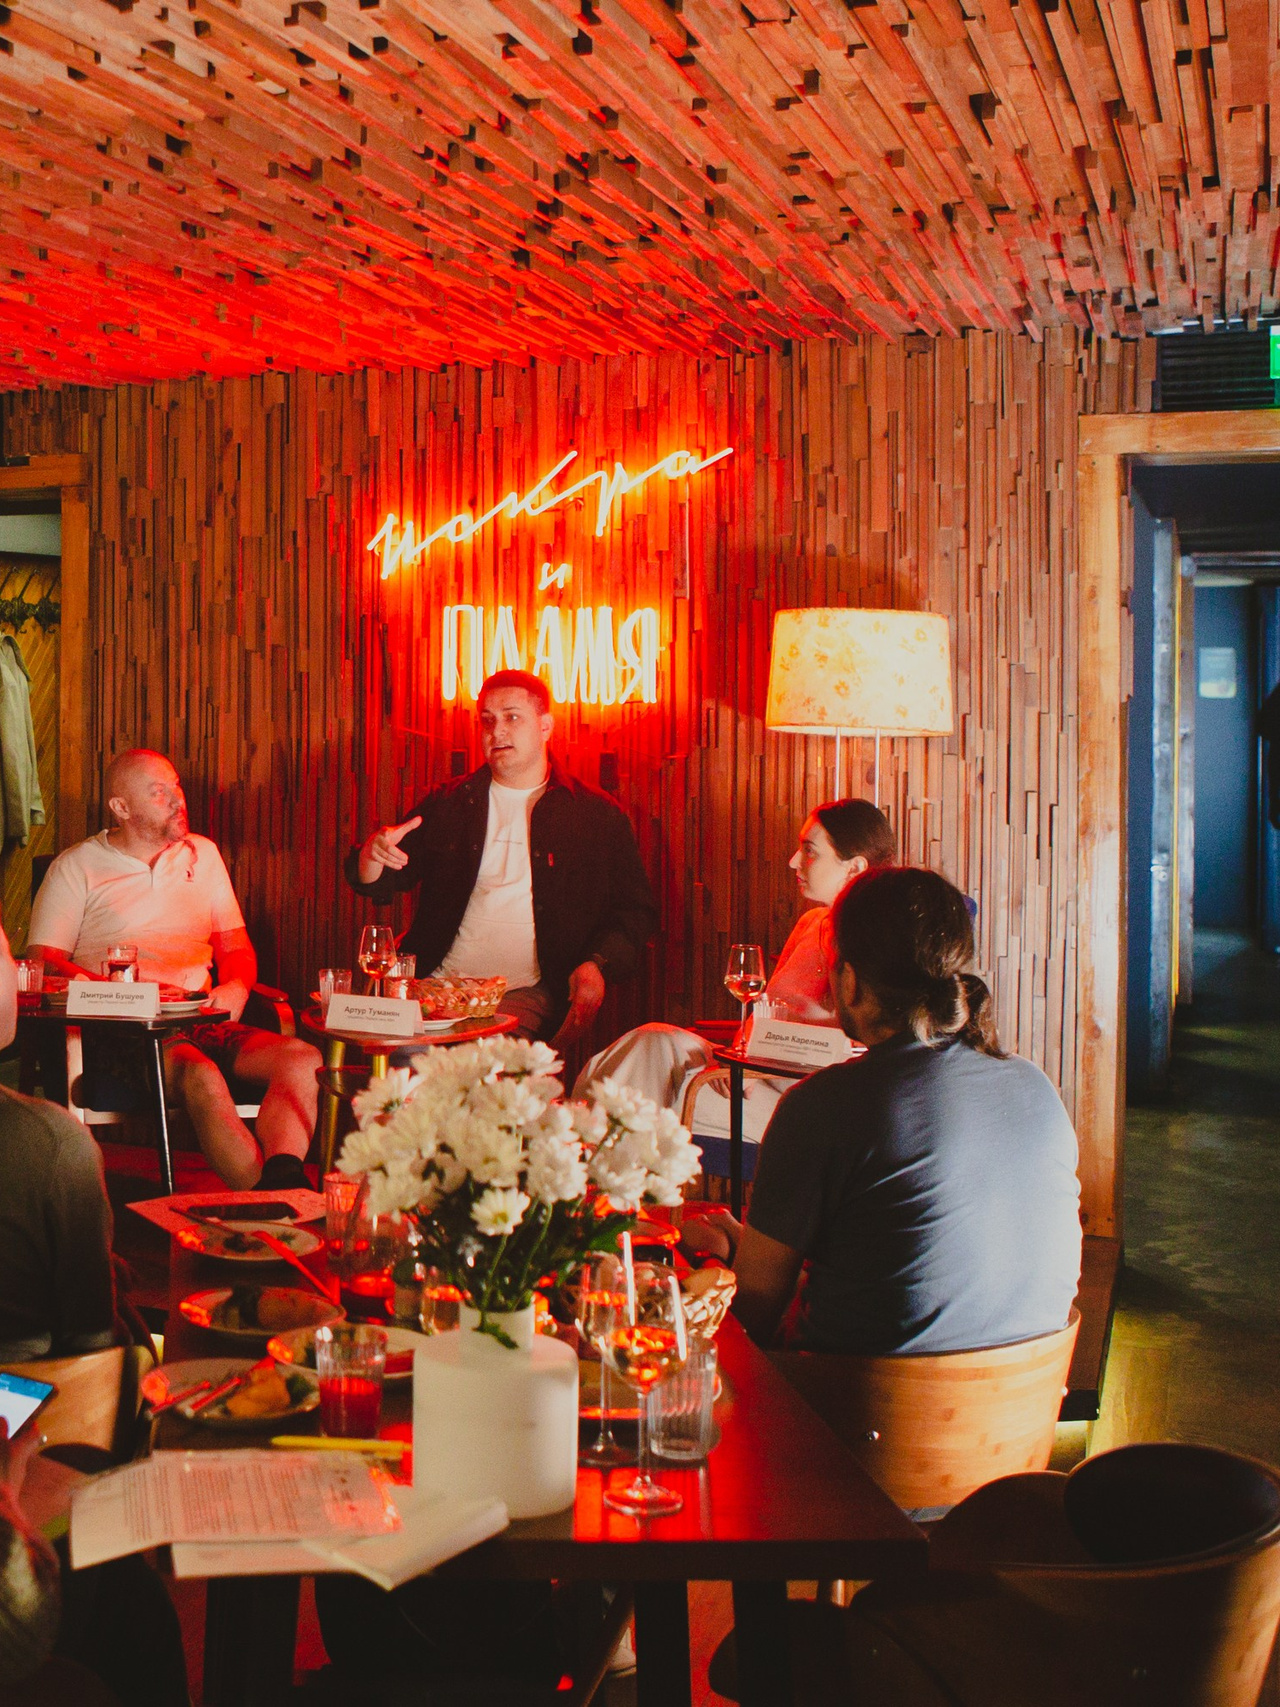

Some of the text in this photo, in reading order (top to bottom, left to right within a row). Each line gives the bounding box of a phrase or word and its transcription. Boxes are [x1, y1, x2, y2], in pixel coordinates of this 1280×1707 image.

[442, 604, 658, 703] ПЛАМЯ
[80, 991, 145, 1001] Дмитрий Бушуев
[344, 1006, 400, 1017] Артур Туманян
[765, 1031, 790, 1042] Дарья
[790, 1035, 829, 1048] Карелина
